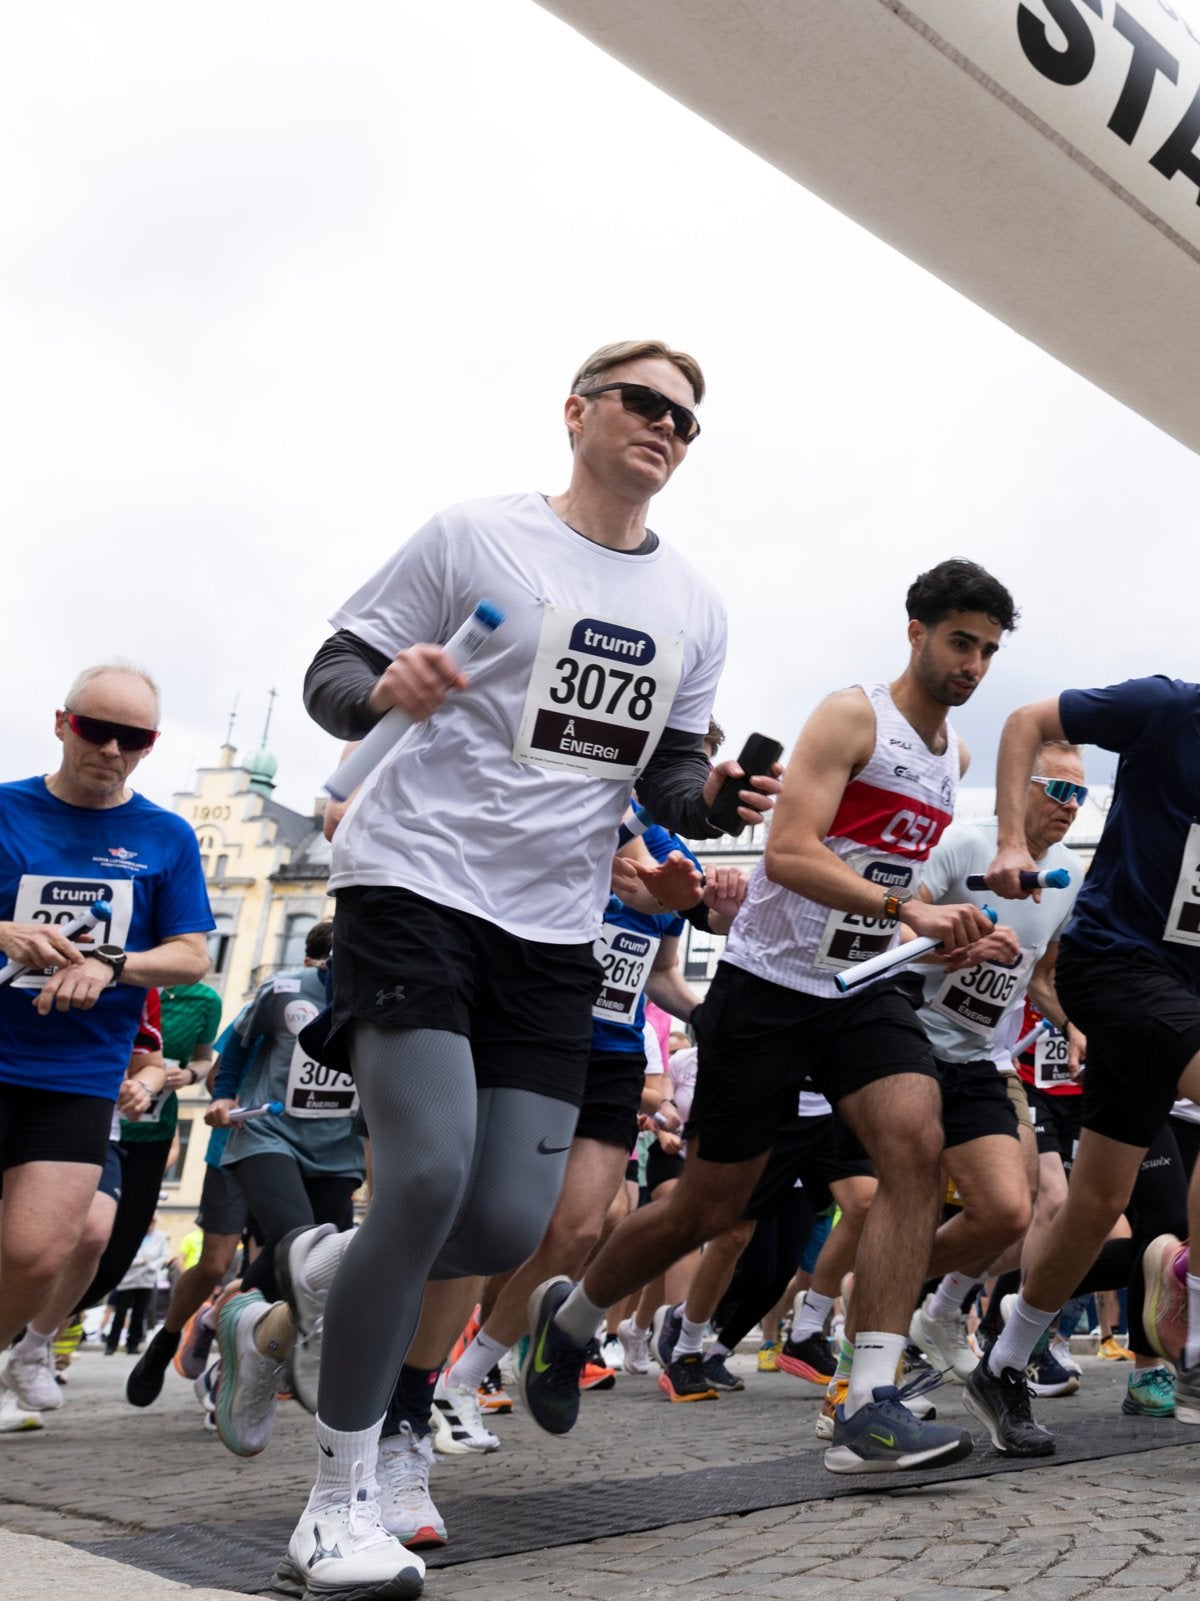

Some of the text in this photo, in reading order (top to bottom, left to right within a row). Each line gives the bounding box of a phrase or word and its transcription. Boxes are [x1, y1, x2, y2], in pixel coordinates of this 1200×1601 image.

[583, 628, 646, 658] trumf
[549, 657, 657, 722] 3078
[562, 719, 576, 737] Å
[559, 738, 620, 760] ENERGI
[871, 867, 910, 886] trumf
[52, 886, 106, 902] trumf
[619, 936, 648, 954] trumf
[602, 953, 645, 988] 2613
[960, 963, 1019, 1002] 3005
[595, 998, 625, 1012] ENERGI
[957, 1005, 993, 1026] ENERGI
[1044, 1040, 1068, 1060] 26
